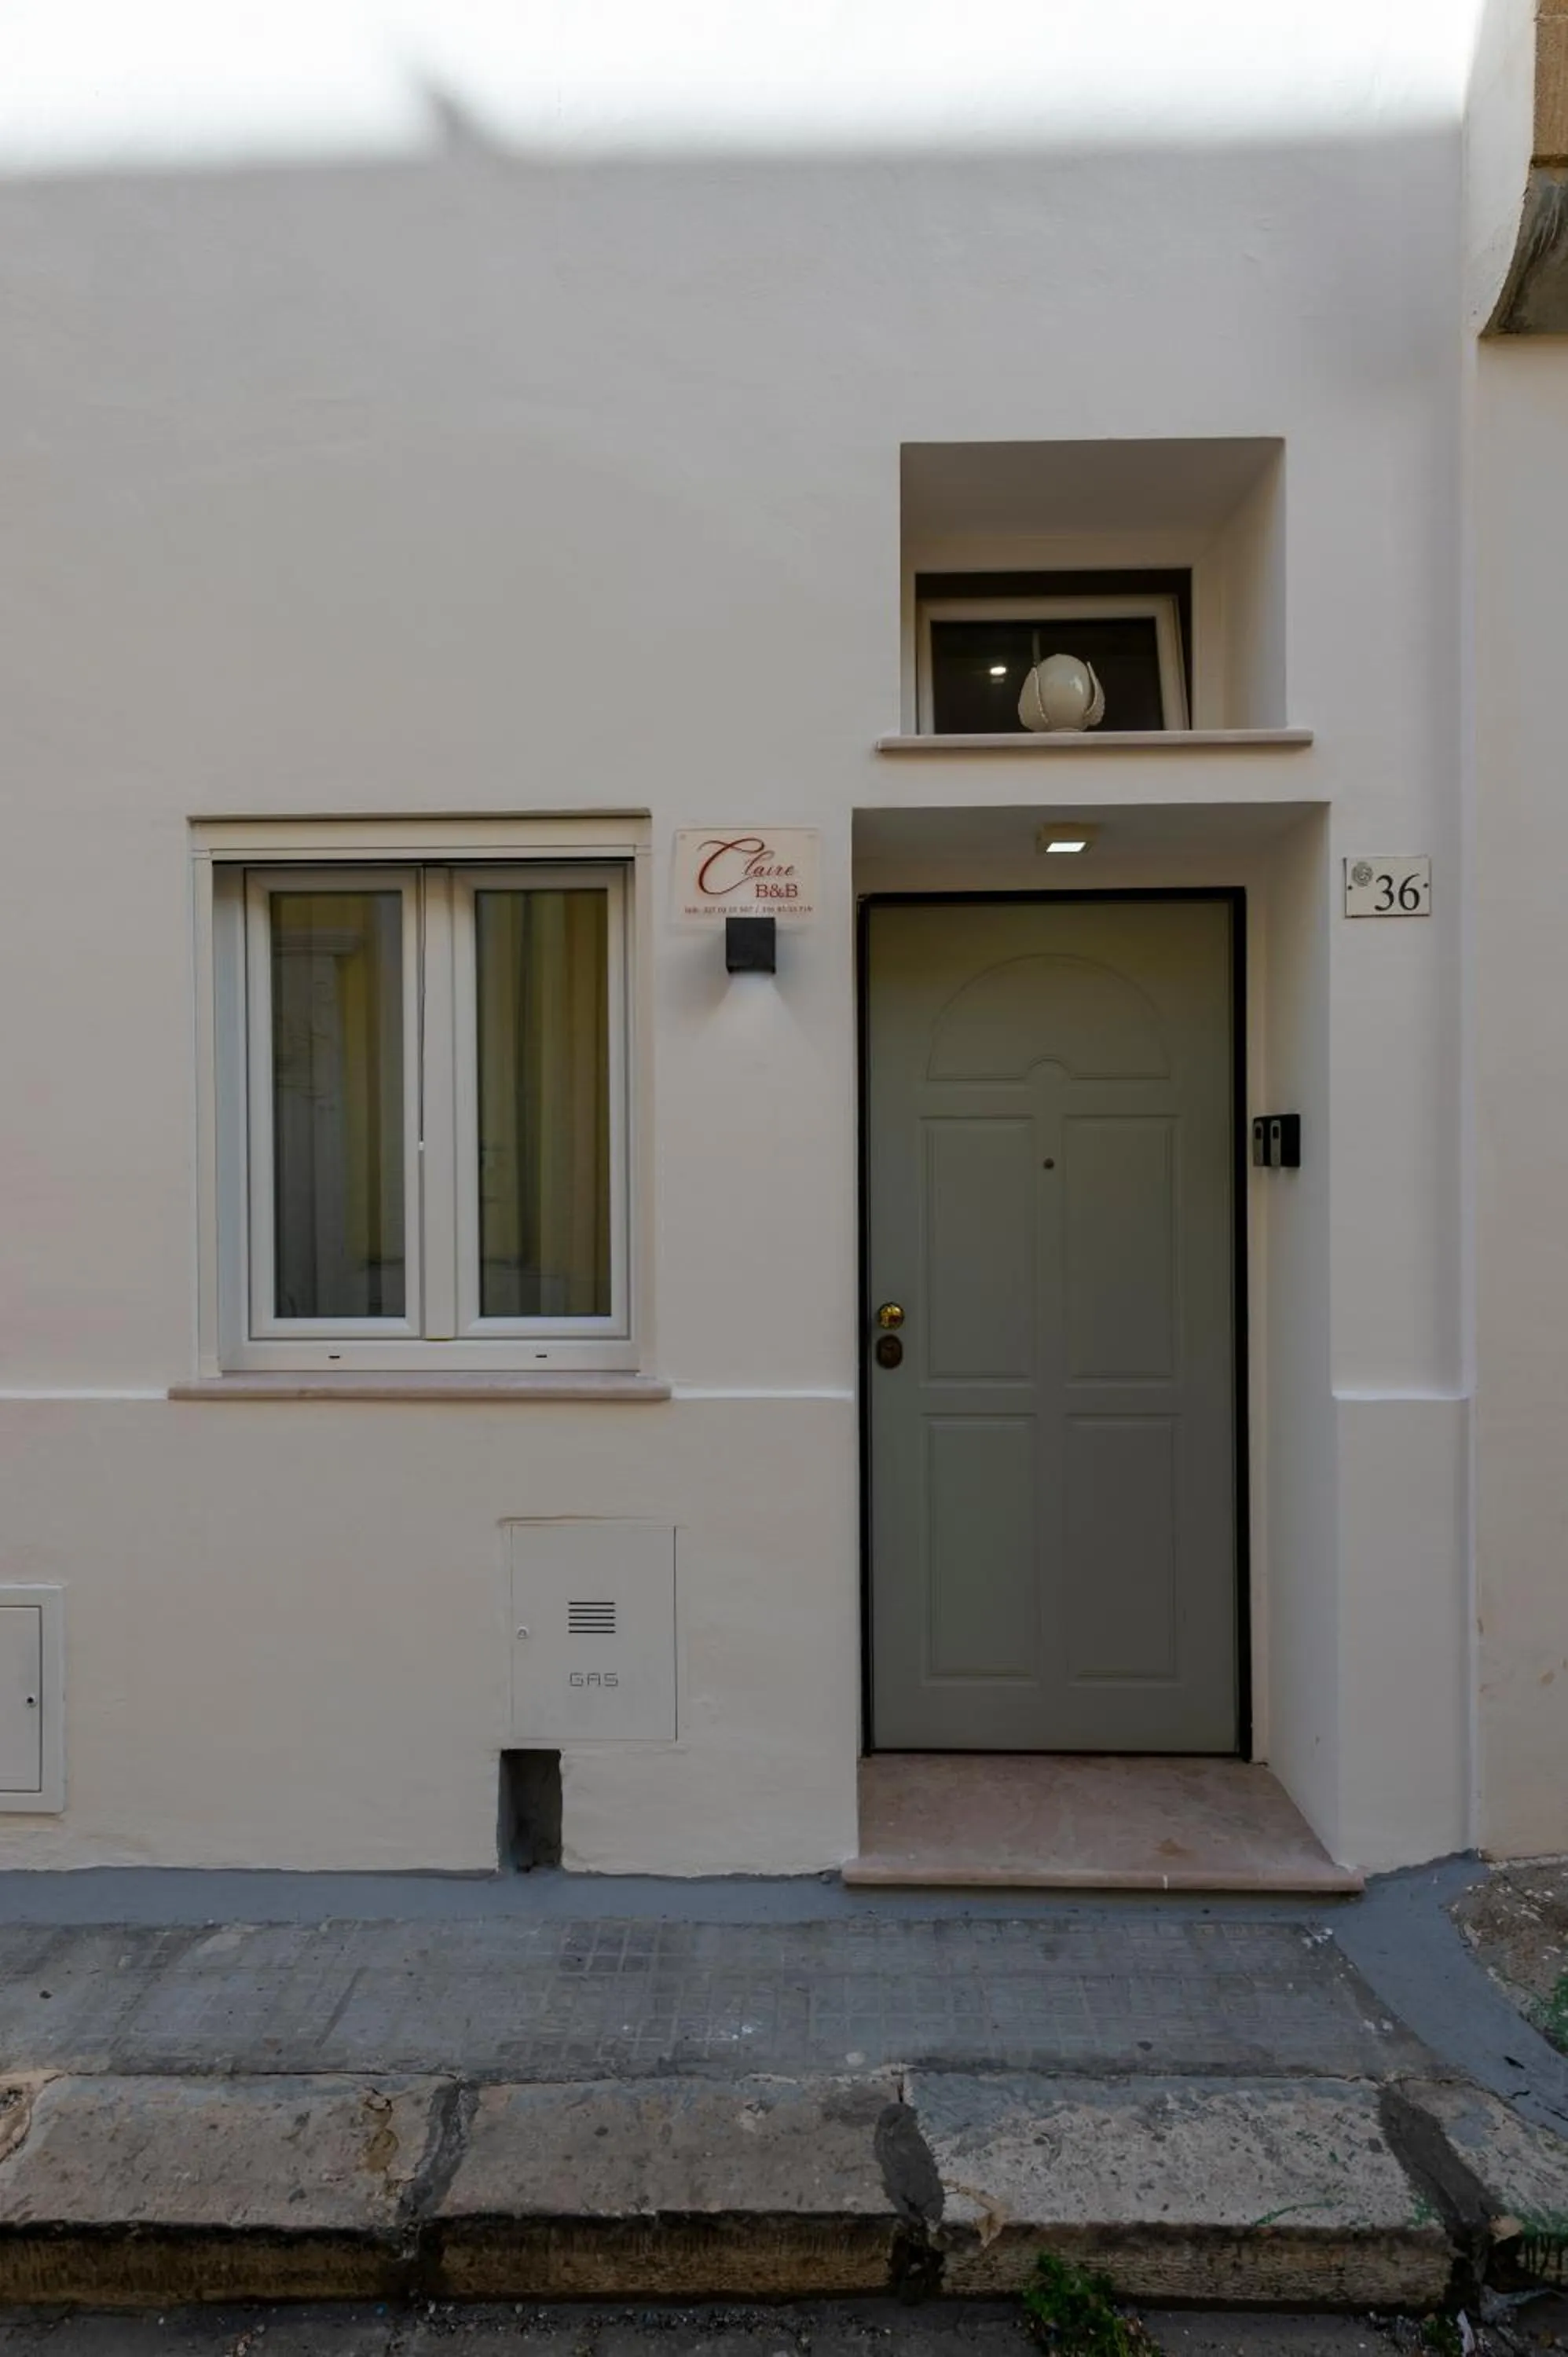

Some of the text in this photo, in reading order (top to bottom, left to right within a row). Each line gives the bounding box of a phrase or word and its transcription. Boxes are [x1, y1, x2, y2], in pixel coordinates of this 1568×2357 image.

[697, 837, 796, 895] Claire
[755, 883, 798, 899] B&B
[1374, 872, 1420, 911] 36
[569, 1672, 618, 1687] GAS
